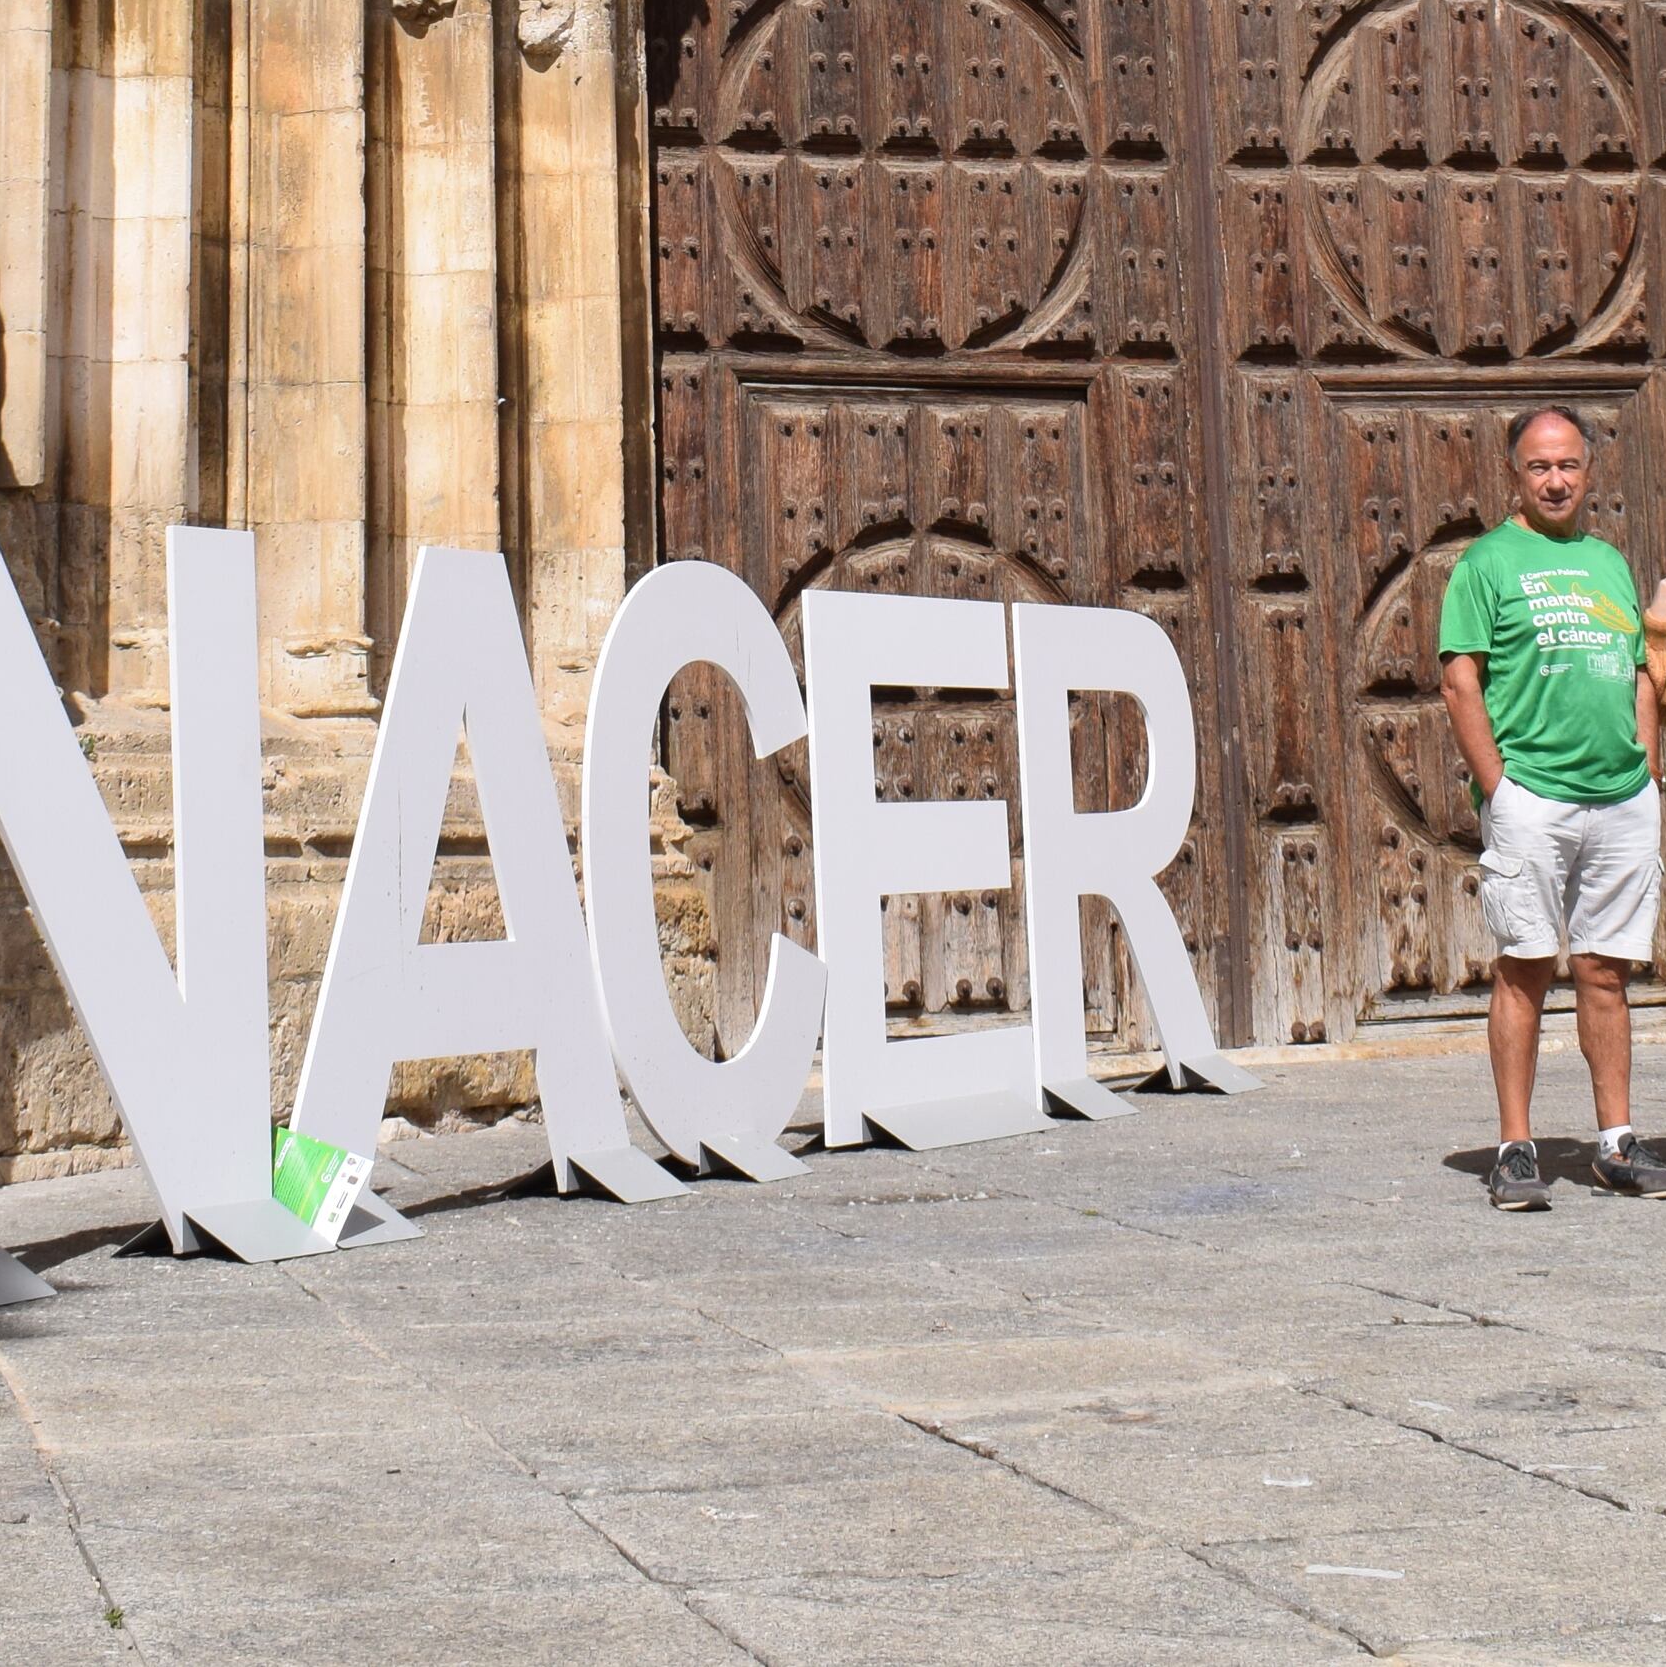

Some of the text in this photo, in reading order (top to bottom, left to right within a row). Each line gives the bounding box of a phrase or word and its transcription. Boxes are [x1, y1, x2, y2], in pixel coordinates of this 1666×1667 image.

[1521, 581, 1548, 595] En
[1528, 592, 1594, 610] marcha
[1533, 608, 1590, 627] contra
[1536, 626, 1613, 645] el cáncer
